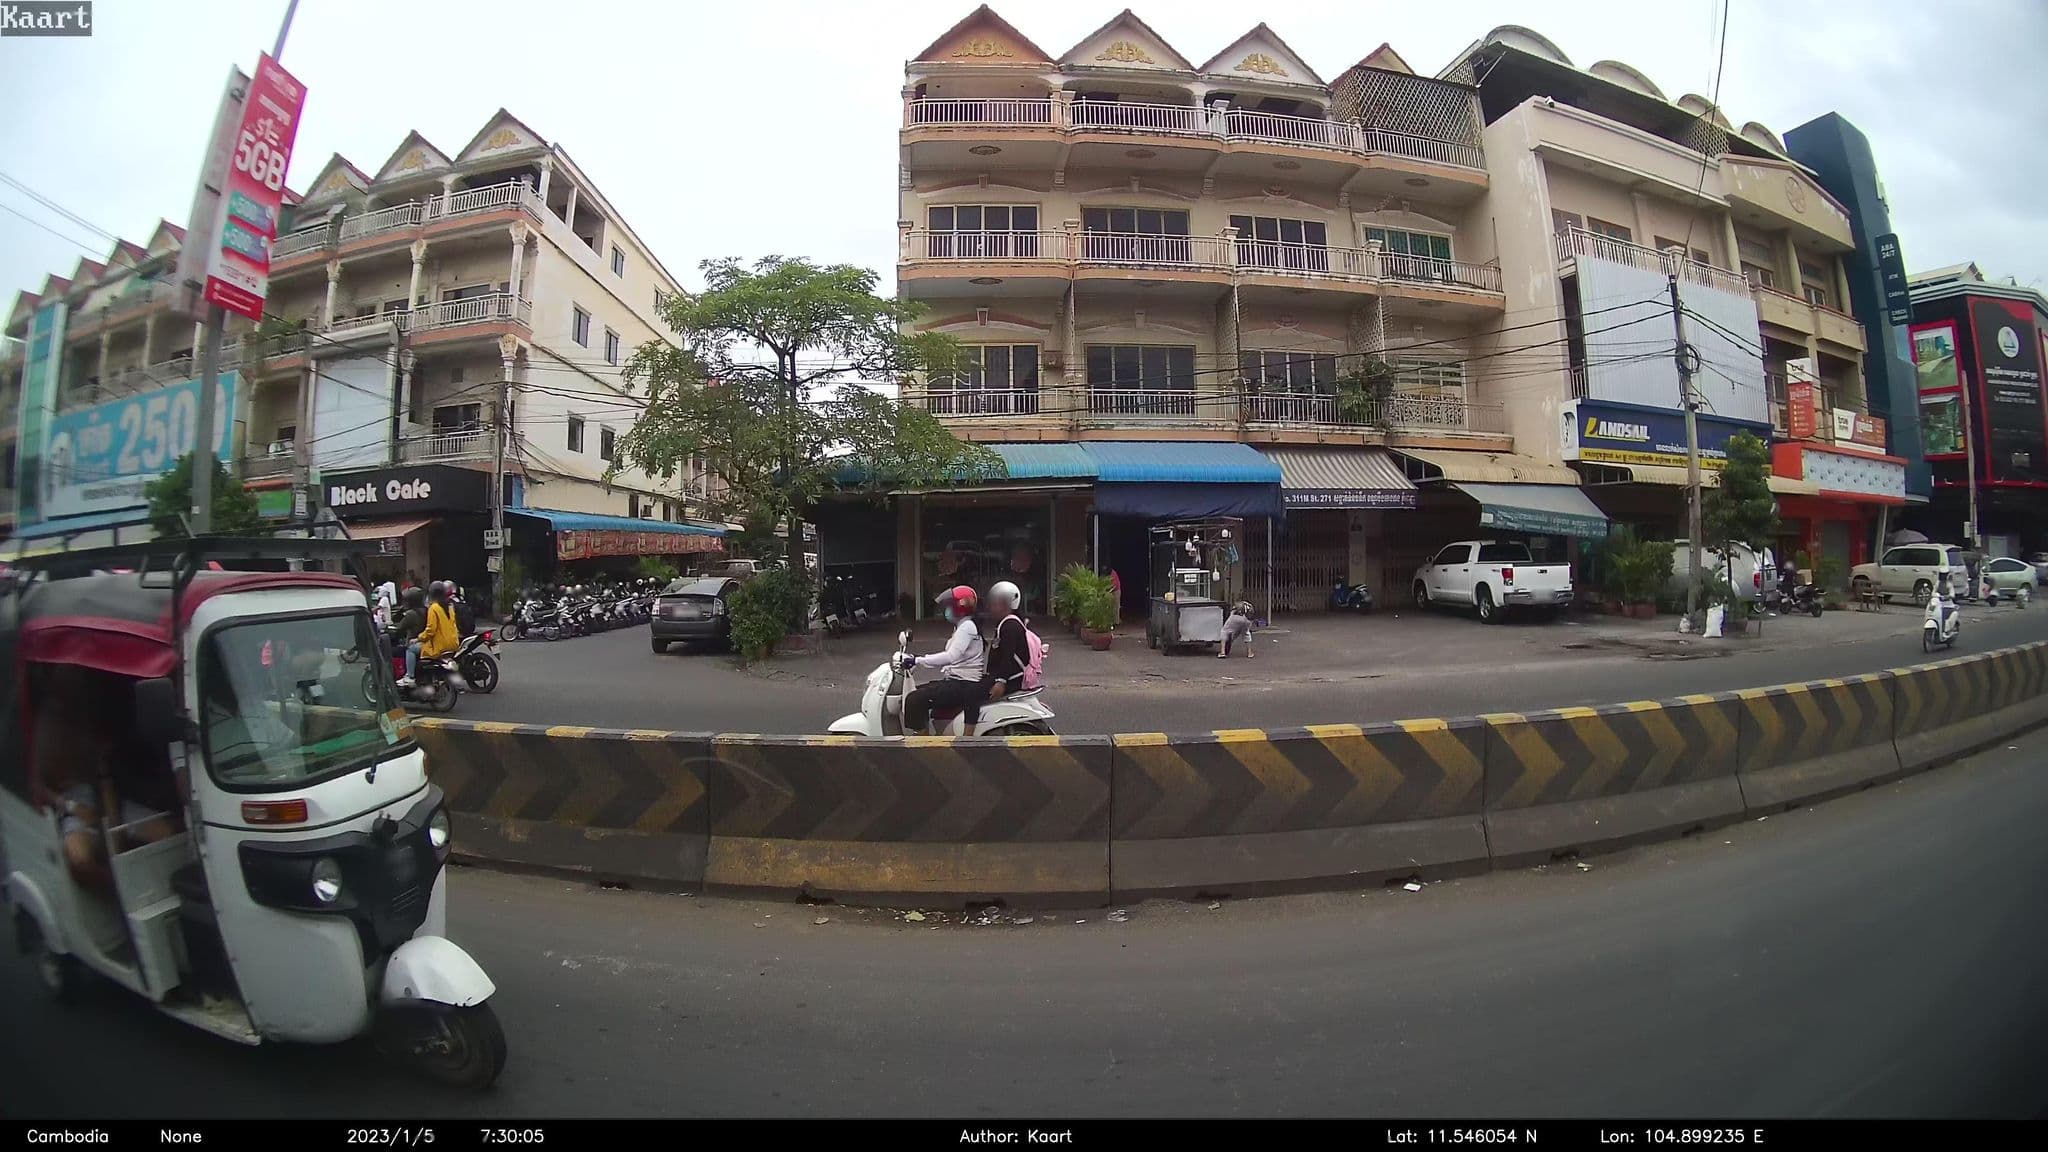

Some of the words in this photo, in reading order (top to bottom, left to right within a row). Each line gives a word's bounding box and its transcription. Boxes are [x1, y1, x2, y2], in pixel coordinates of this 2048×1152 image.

[235, 130, 286, 191] 5GB
[330, 483, 378, 506] Black
[386, 478, 431, 501] Cafe
[1320, 494, 1332, 503] 271
